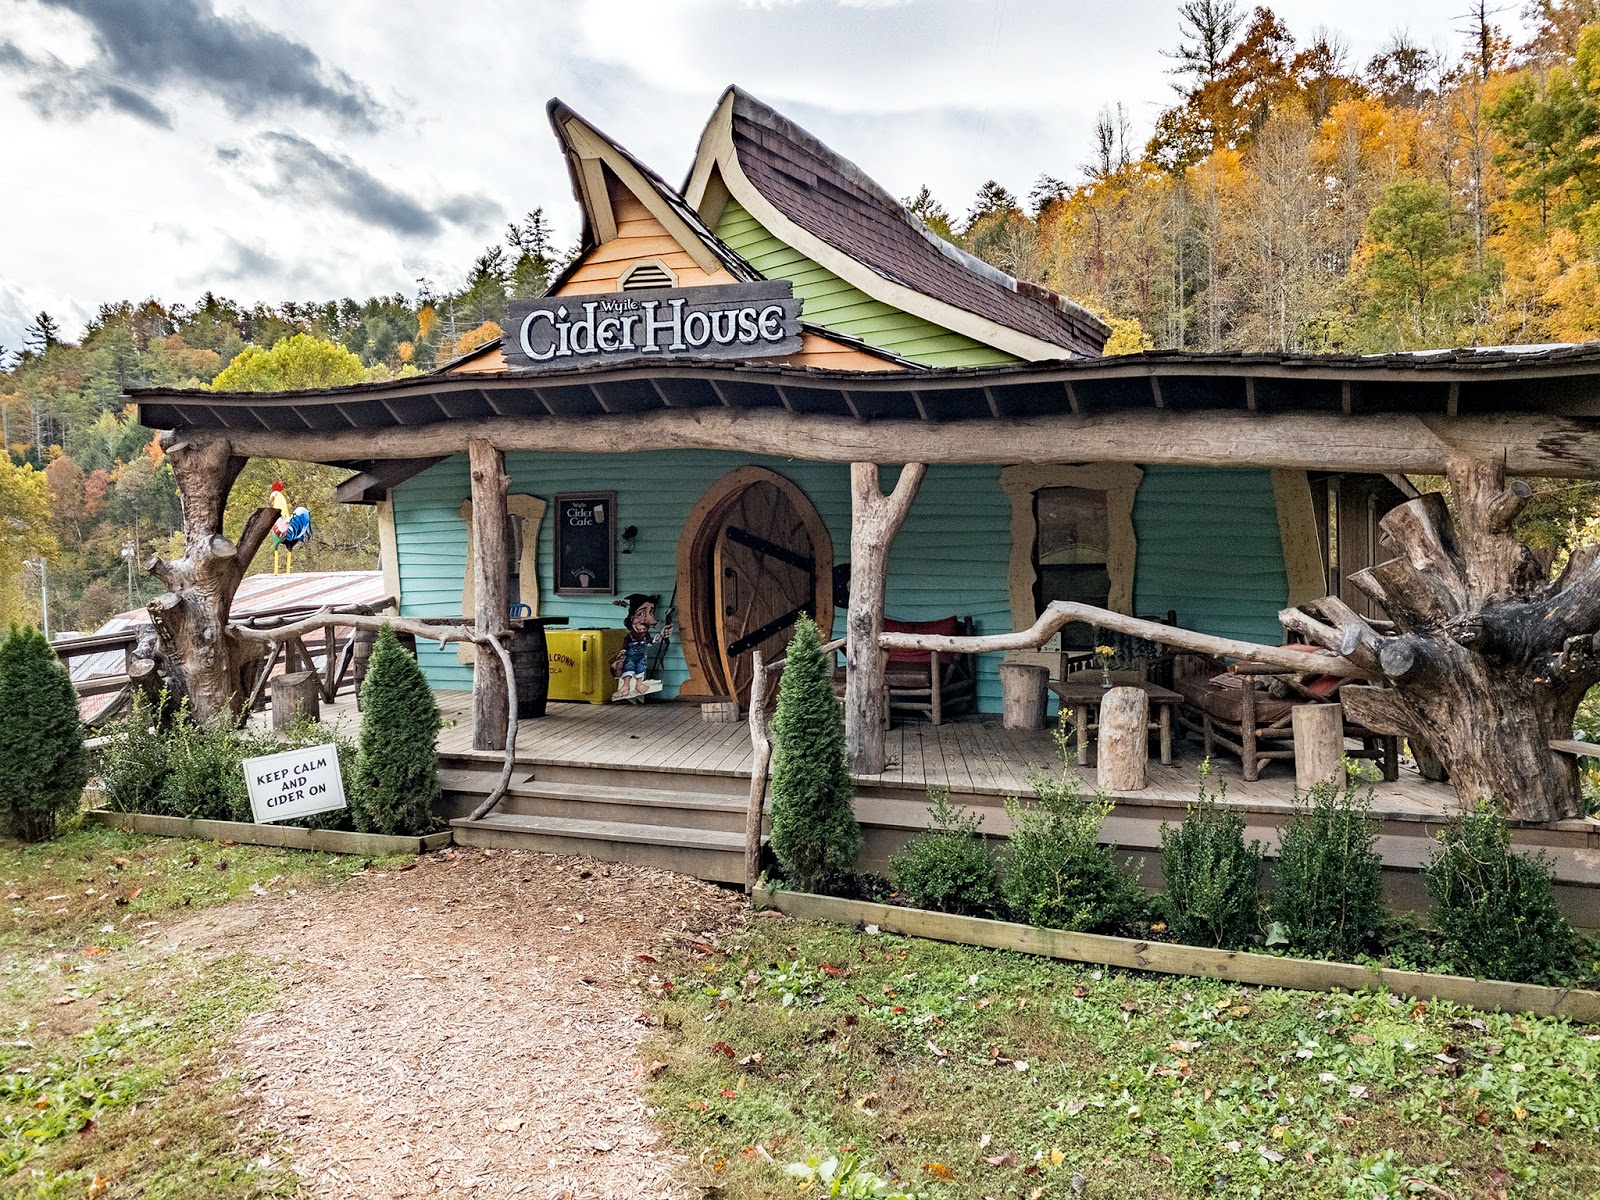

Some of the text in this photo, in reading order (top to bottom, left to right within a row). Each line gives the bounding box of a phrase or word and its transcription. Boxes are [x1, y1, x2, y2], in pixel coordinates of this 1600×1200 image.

[601, 299, 639, 313] Wyile
[566, 508, 592, 518] Cider
[570, 517, 593, 527] Cafe
[553, 653, 575, 669] CROWN
[257, 758, 327, 785] KEEP CALM
[281, 777, 307, 791] AND
[267, 783, 326, 807] CIDER ON
